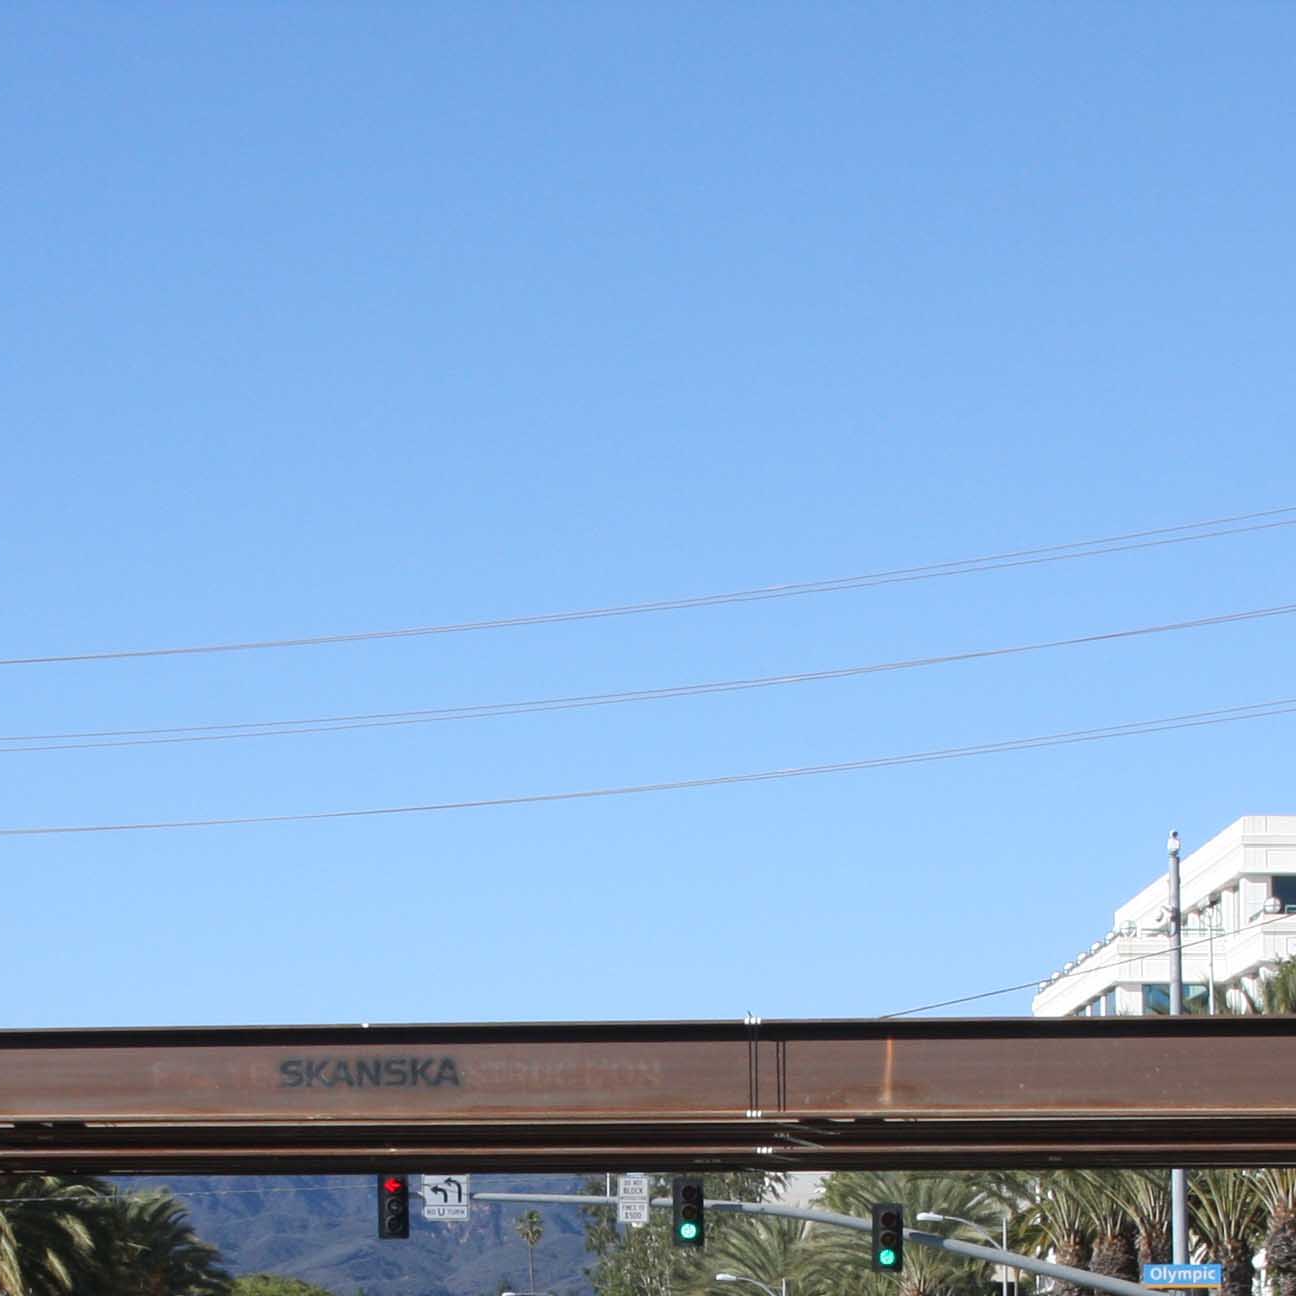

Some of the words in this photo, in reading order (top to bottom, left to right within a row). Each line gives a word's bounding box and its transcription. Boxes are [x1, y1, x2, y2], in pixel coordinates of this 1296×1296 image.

[279, 1056, 461, 1089] SKANSKA
[437, 1207, 446, 1217] U
[1150, 1266, 1217, 1284] Olympic
